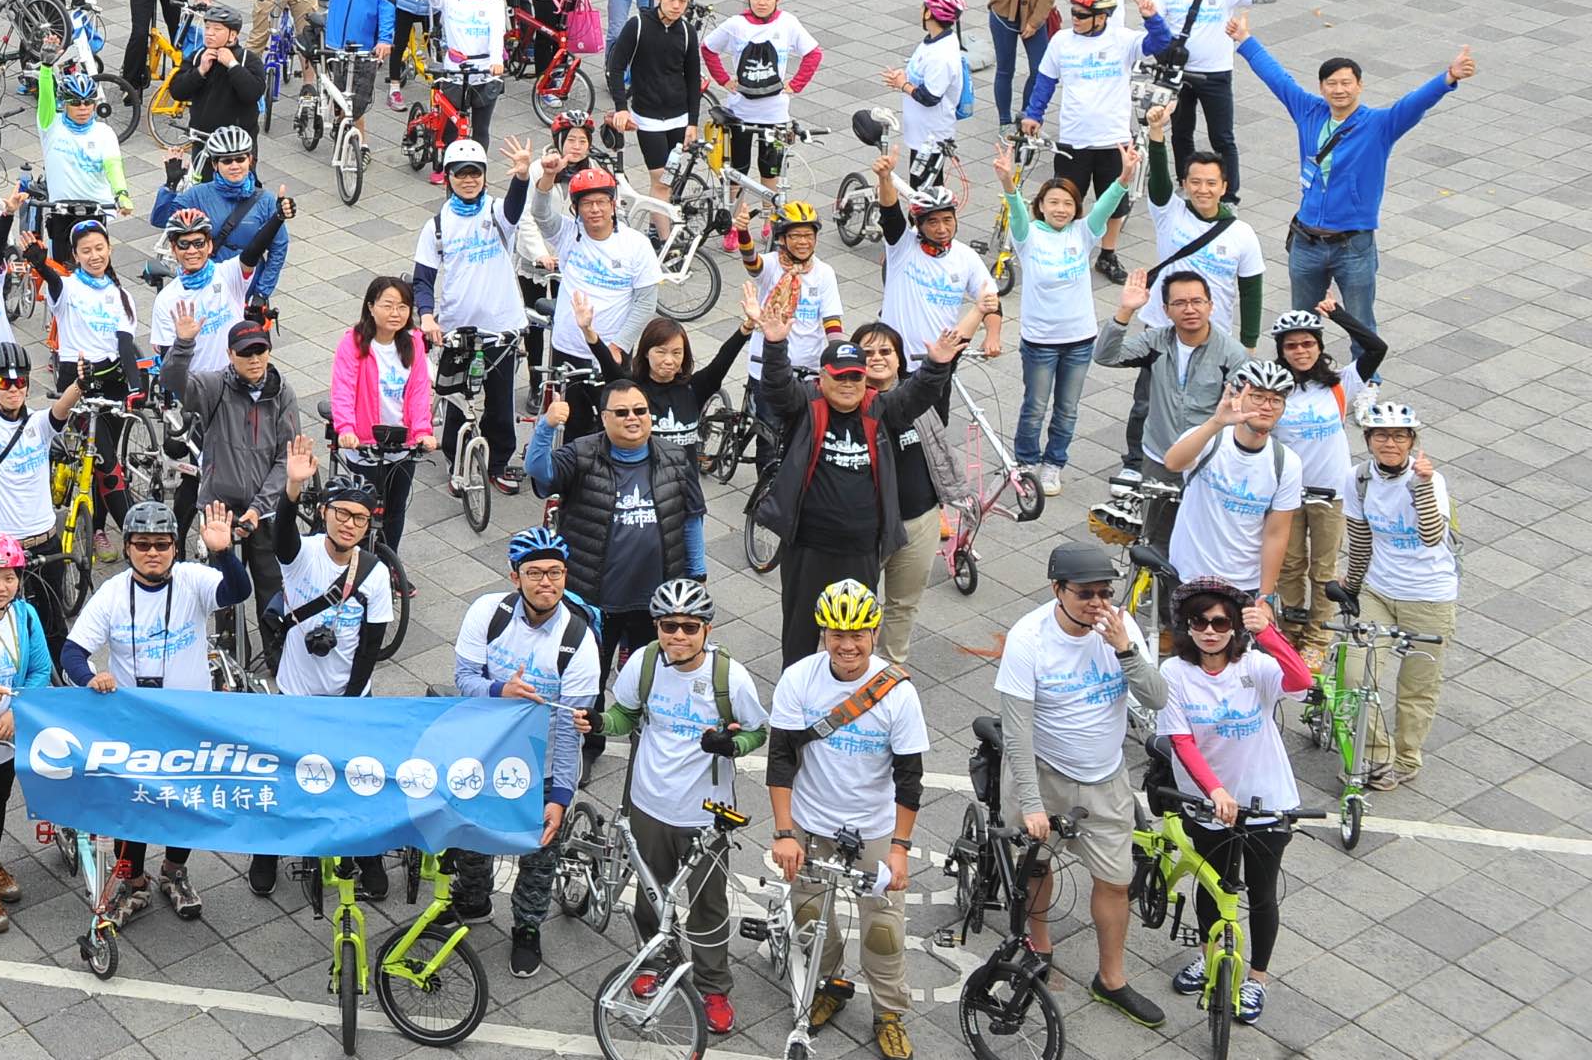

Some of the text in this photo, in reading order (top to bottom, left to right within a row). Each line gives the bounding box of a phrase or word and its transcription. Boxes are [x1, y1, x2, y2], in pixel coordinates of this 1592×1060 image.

[84, 740, 281, 774] Pacific
[130, 782, 278, 814] 太平洋自行車
